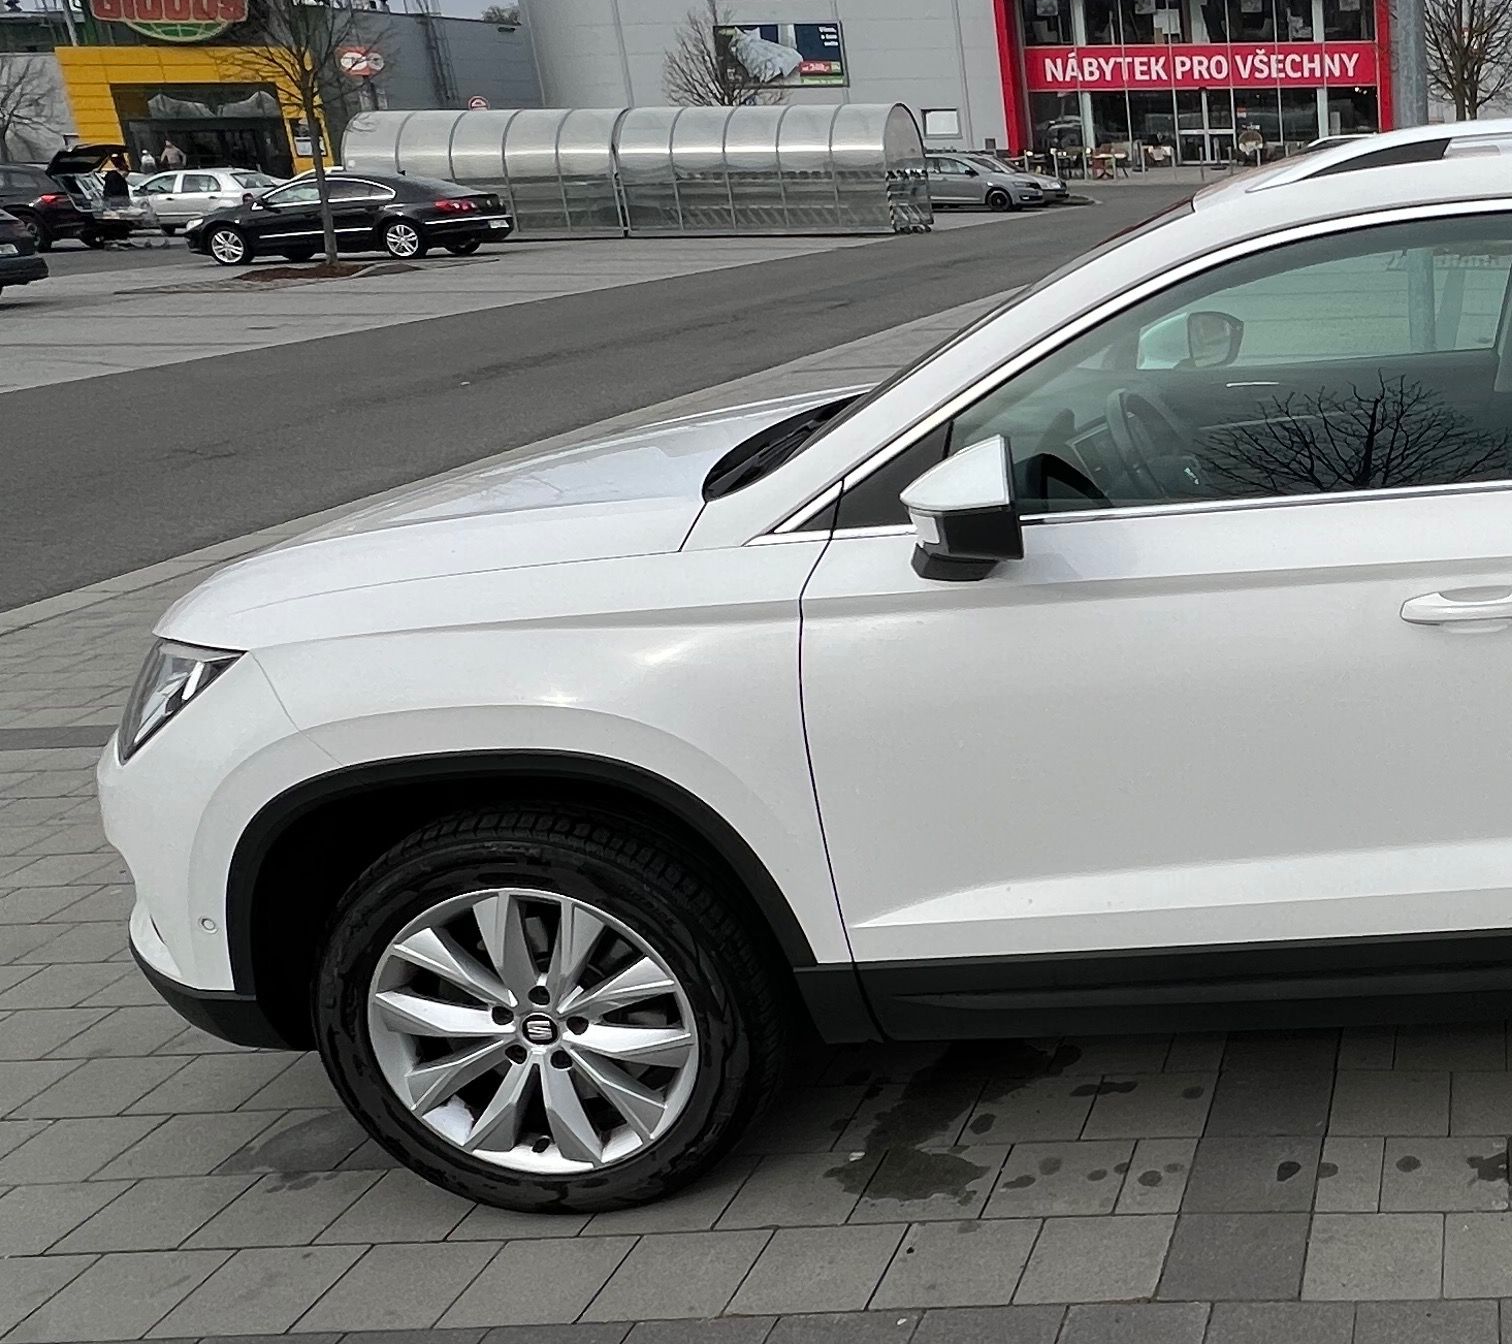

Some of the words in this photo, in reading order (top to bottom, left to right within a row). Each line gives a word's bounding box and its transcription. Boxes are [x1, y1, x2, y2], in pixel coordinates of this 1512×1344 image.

[1045, 51, 1168, 83] NÁBYTEK
[1175, 55, 1229, 81] PRO
[1235, 49, 1360, 80] VŠECHNY
